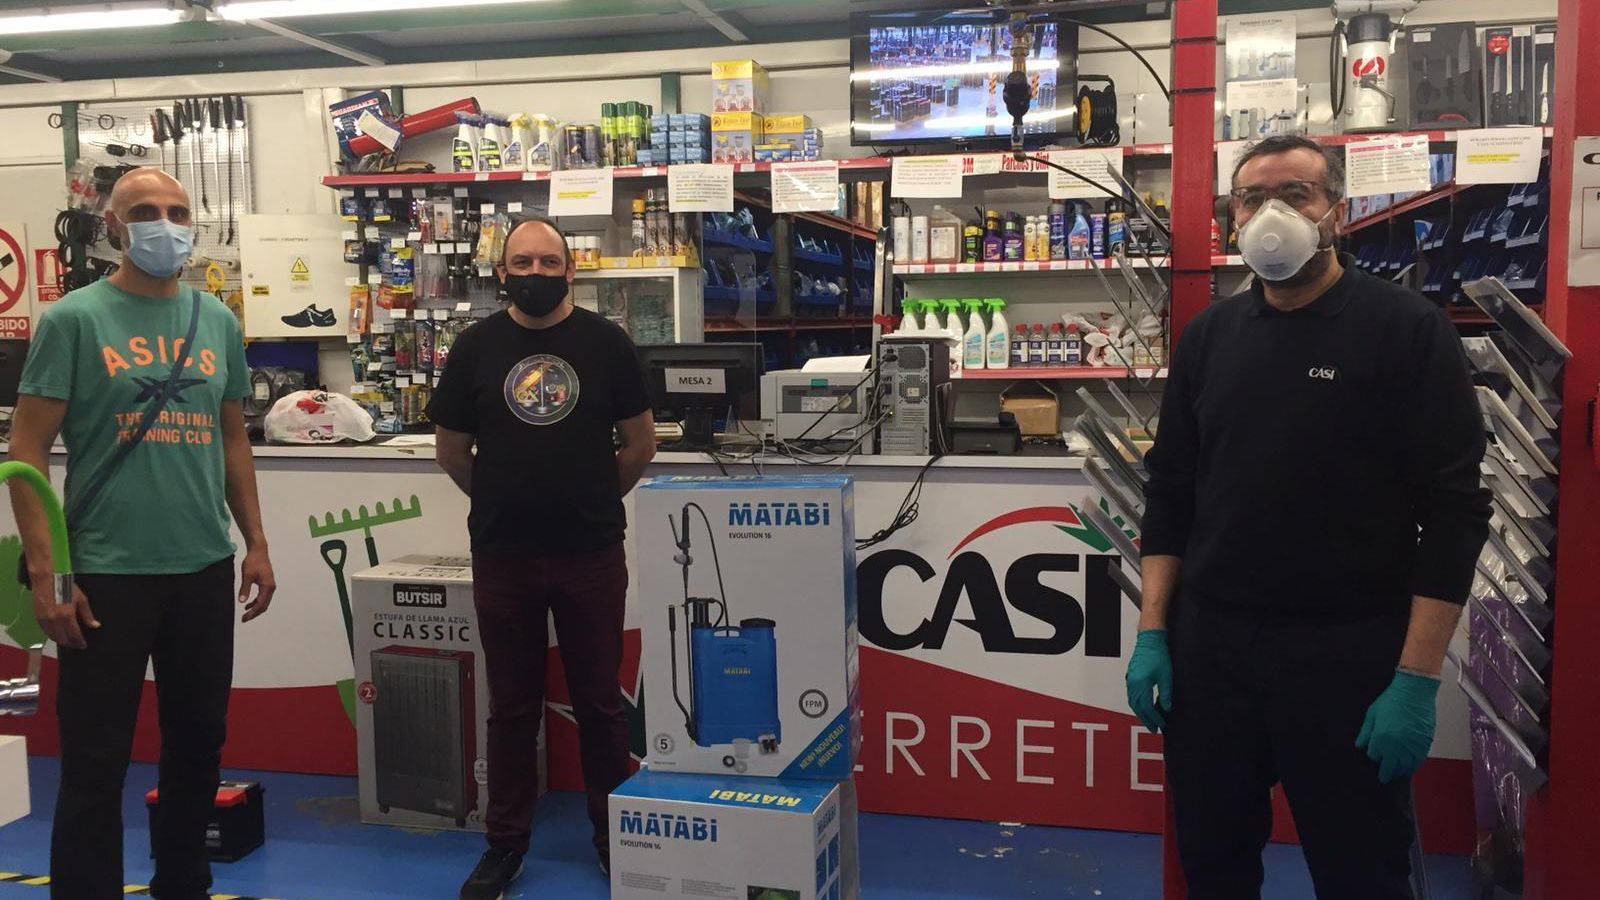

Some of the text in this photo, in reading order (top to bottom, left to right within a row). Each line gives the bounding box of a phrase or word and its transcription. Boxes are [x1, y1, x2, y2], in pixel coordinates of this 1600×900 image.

[1309, 367, 1335, 380] CASI
[679, 377, 712, 385] MESA 2
[159, 410, 214, 427] RIGINAL
[185, 430, 212, 444] CLUB
[728, 502, 830, 526] MATABI
[396, 591, 443, 605] BUTSIR
[855, 549, 1122, 657] CASI
[374, 612, 470, 624] ESTUFA DE LLAMA AZUL
[373, 622, 470, 642] CLASSIC
[365, 687, 372, 698] 2
[805, 700, 822, 708] FPM
[660, 738, 668, 750] 5
[854, 711, 1164, 792] RRETE
[708, 789, 801, 807] MATABI
[620, 810, 718, 843] MATABI
[620, 839, 653, 849] EVOLUTION
